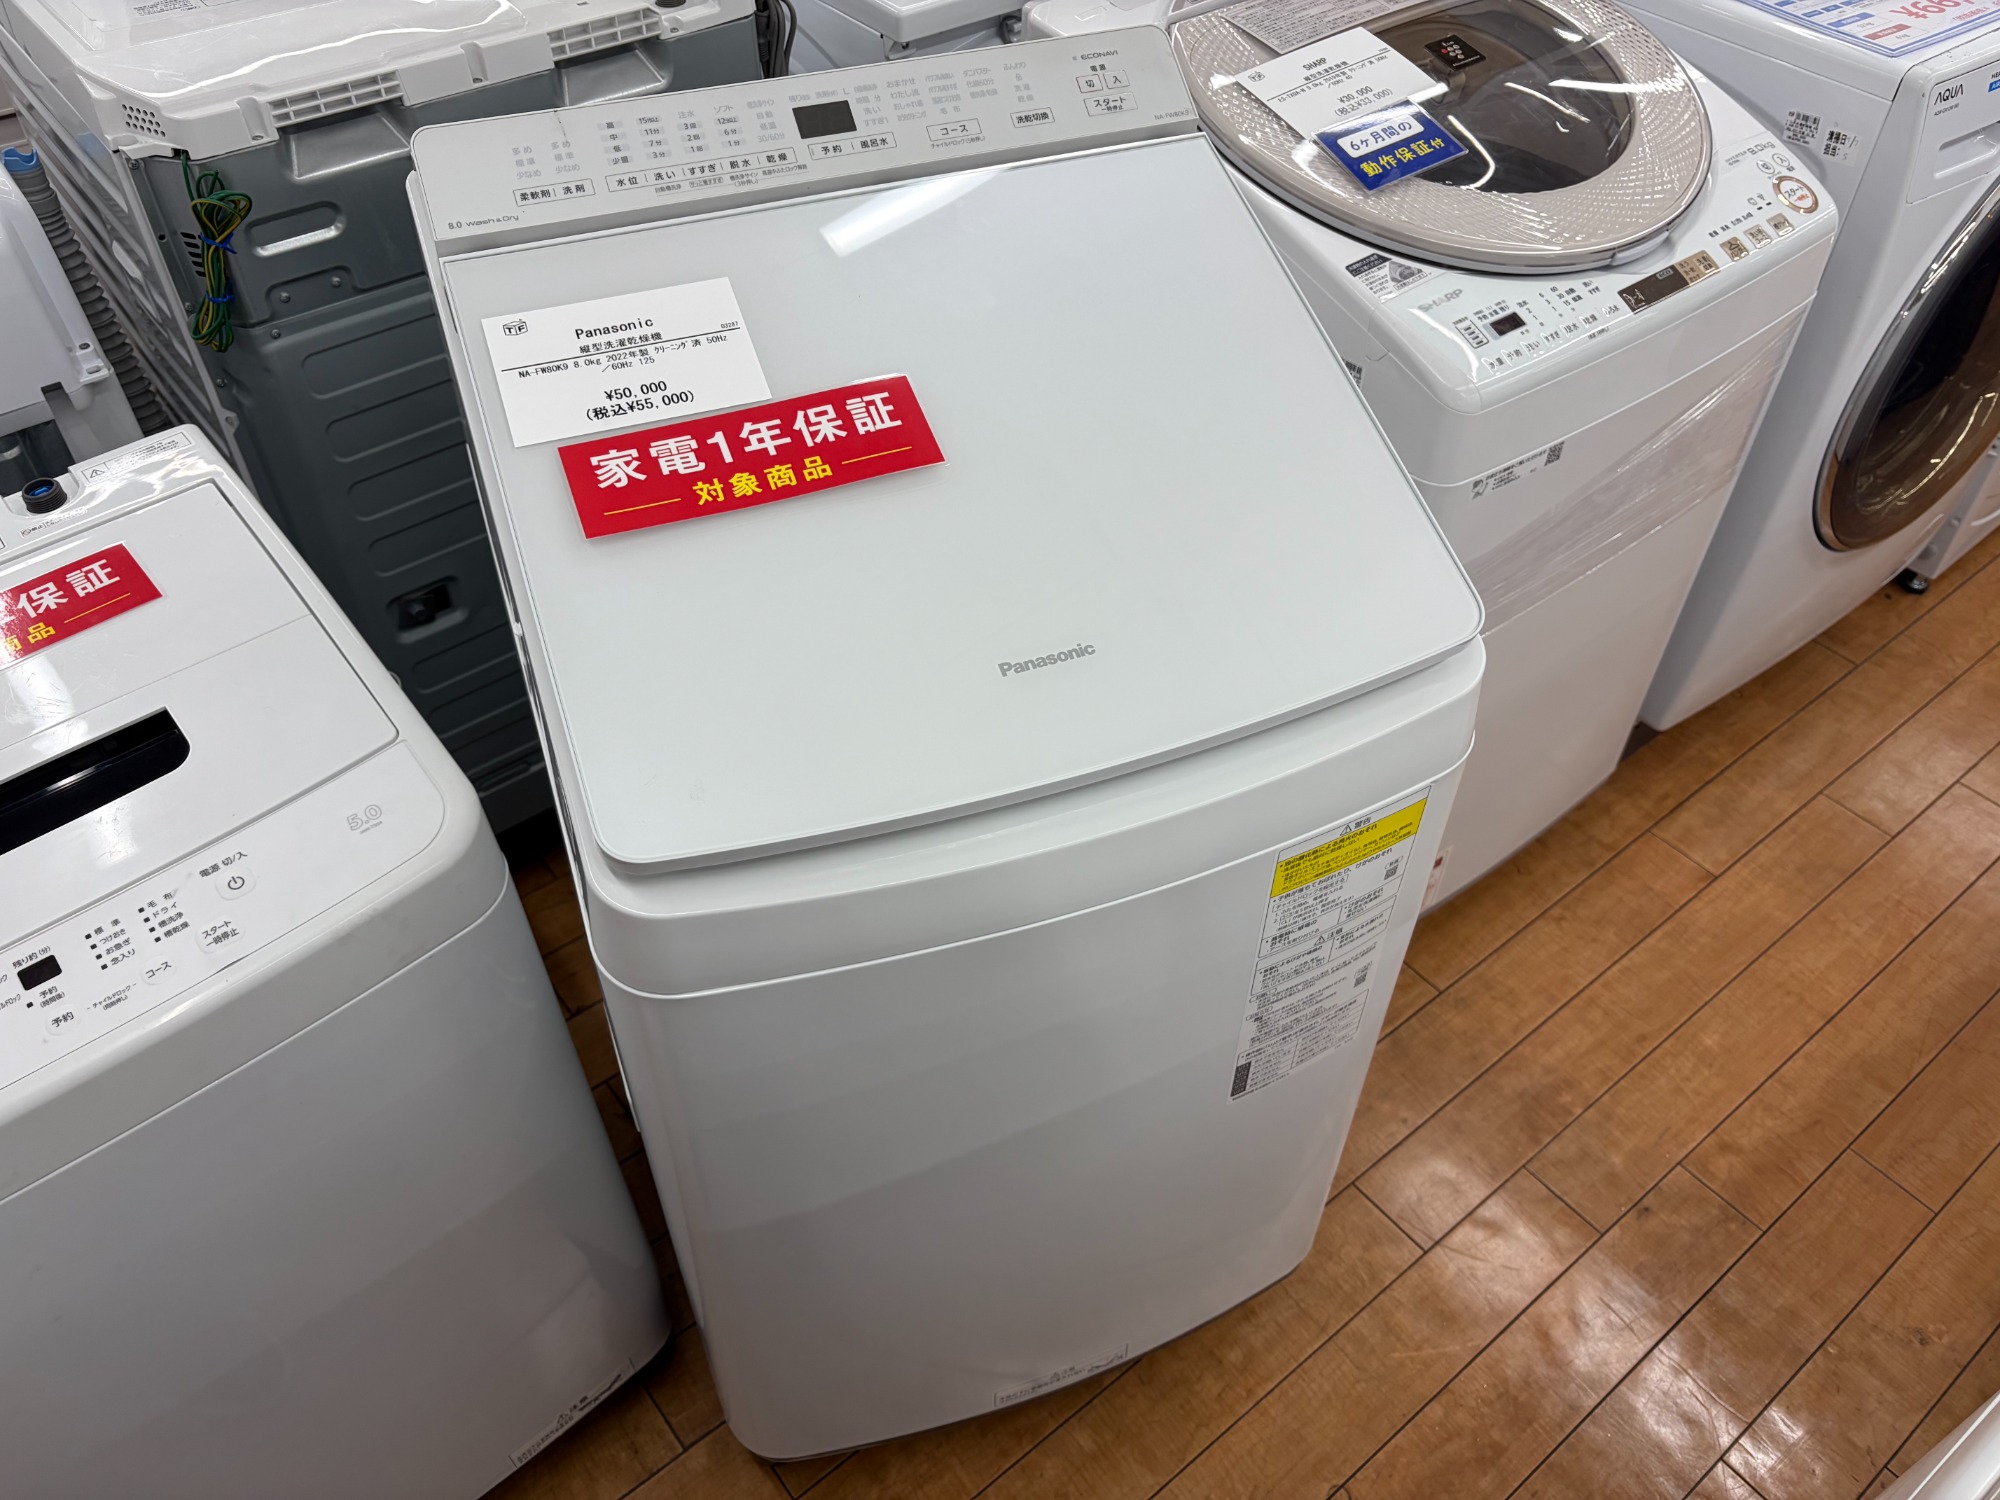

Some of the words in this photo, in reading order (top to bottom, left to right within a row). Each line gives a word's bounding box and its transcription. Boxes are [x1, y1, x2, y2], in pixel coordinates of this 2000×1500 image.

[1080, 50, 1118, 61] ECONAVI
[1303, 57, 1327, 71] SHARP
[1085, 80, 1095, 88] 切
[1113, 76, 1122, 84] 入
[1093, 96, 1127, 108] スタート
[1934, 83, 1964, 106] AQUA
[1016, 112, 1050, 124] 洗乾切換
[940, 124, 969, 136] コース
[821, 145, 842, 155] 予約
[860, 137, 889, 149] 風呂水
[729, 159, 751, 169] 脱水
[766, 152, 788, 164] 乾燥
[1360, 137, 1445, 177] 動作保証付
[517, 170, 541, 179] 少なめ
[555, 164, 580, 174] 少なめ
[654, 171, 676, 181] 洗い
[688, 163, 717, 175] すすぎ
[562, 184, 585, 195] 洗剤
[616, 176, 638, 187] 水位
[520, 189, 550, 201] 柔軟剤
[448, 221, 462, 229] 8.0
[1416, 288, 1463, 314] SHARP
[575, 318, 654, 340] Panasonic
[518, 363, 569, 379] NA-FW80K9
[573, 357, 602, 370] 8.0kg
[606, 348, 649, 363] 2022年製
[706, 334, 727, 346] 50Hz
[638, 356, 655, 365] 125
[604, 380, 667, 402] ¥50,000
[585, 390, 695, 422] (税込¥55,000)
[589, 391, 902, 491] 家電1年保証
[693, 456, 833, 506] 対象商品
[997, 643, 1096, 677] Panasonic
[347, 804, 382, 831] 5.0
[199, 864, 221, 878] 電源
[222, 851, 248, 867] 切/入
[152, 901, 177, 918] ドライ
[94, 918, 121, 935] 標準
[158, 911, 184, 929] 槽洗浄
[99, 928, 126, 945] つけおき
[164, 921, 190, 939] 槽乾燥
[202, 920, 231, 939] スタート
[205, 927, 239, 947] 一時停止
[105, 937, 131, 955] お急ぎ
[110, 948, 136, 966] 念入り
[145, 961, 172, 979] コース
[39, 986, 58, 999] 予約
[51, 1011, 75, 1028] 予約
